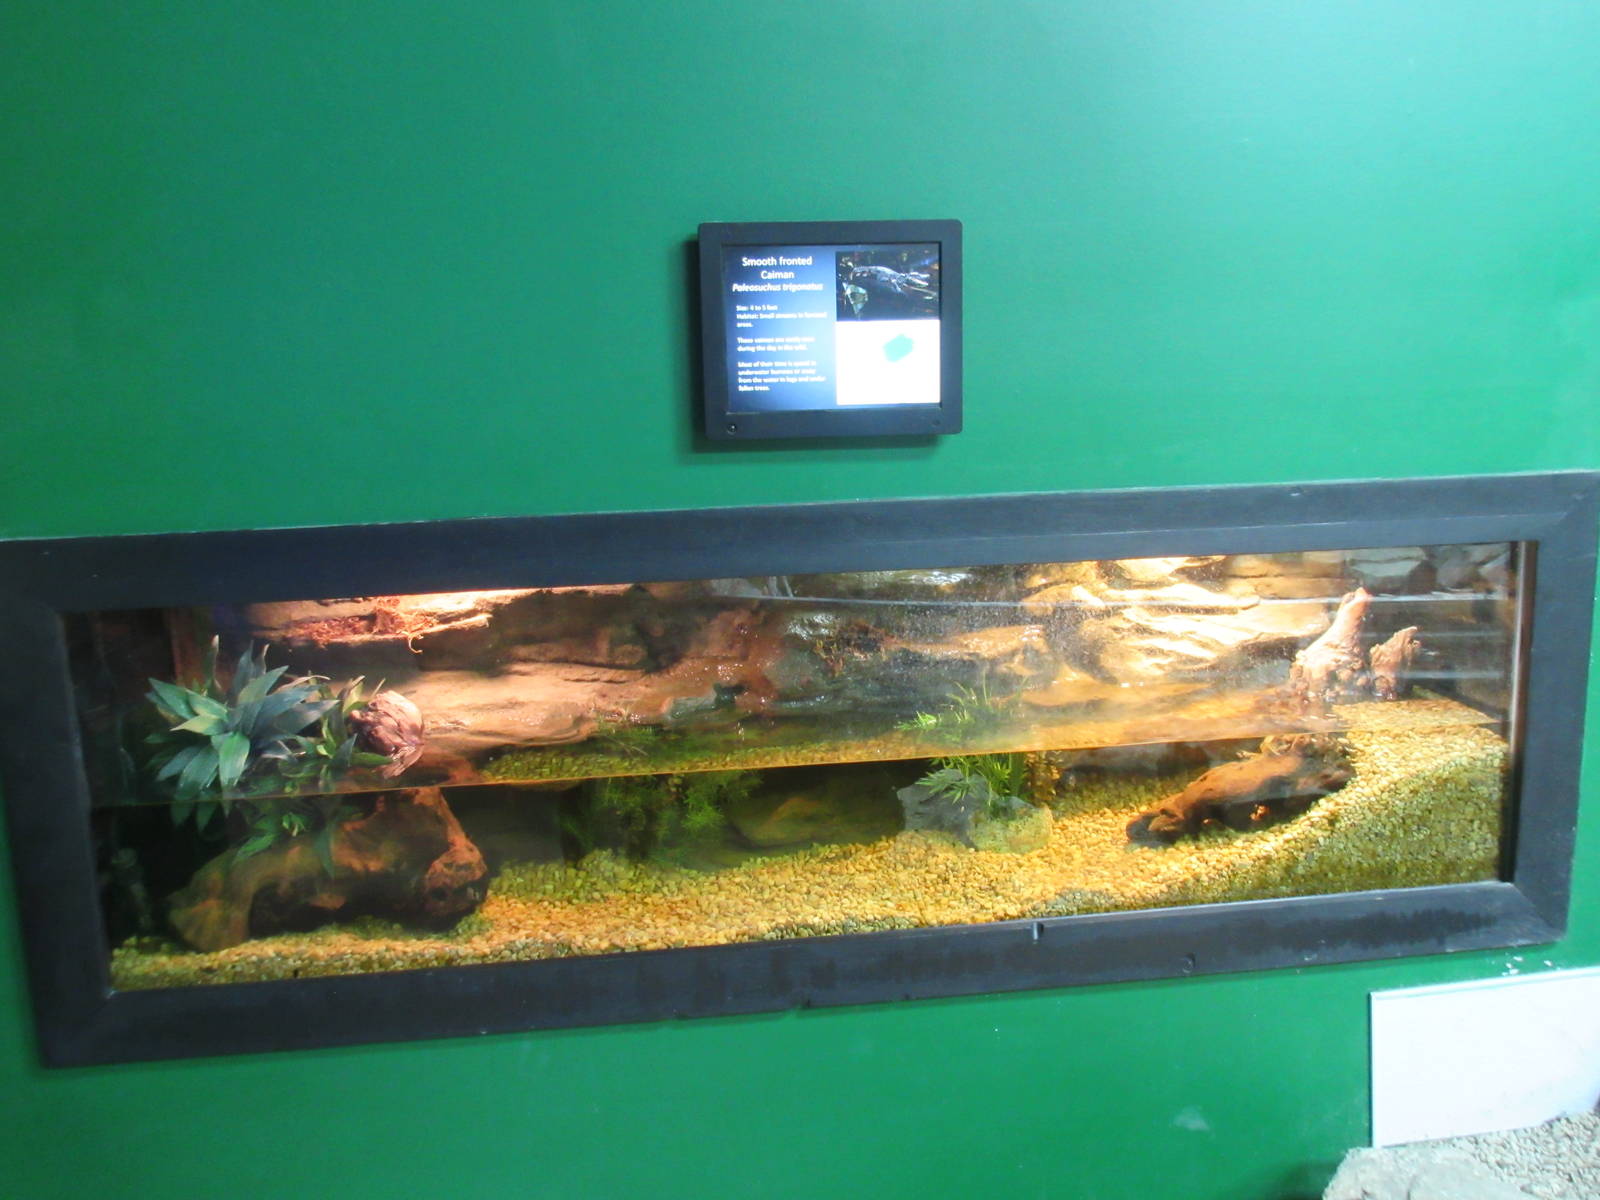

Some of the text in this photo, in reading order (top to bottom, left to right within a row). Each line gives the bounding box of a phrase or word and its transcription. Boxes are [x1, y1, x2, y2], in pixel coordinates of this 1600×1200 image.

[742, 256, 813, 266] Smooth fronted
[760, 270, 795, 280] Caiman
[732, 283, 824, 292] Paleosuchus trigonatus
